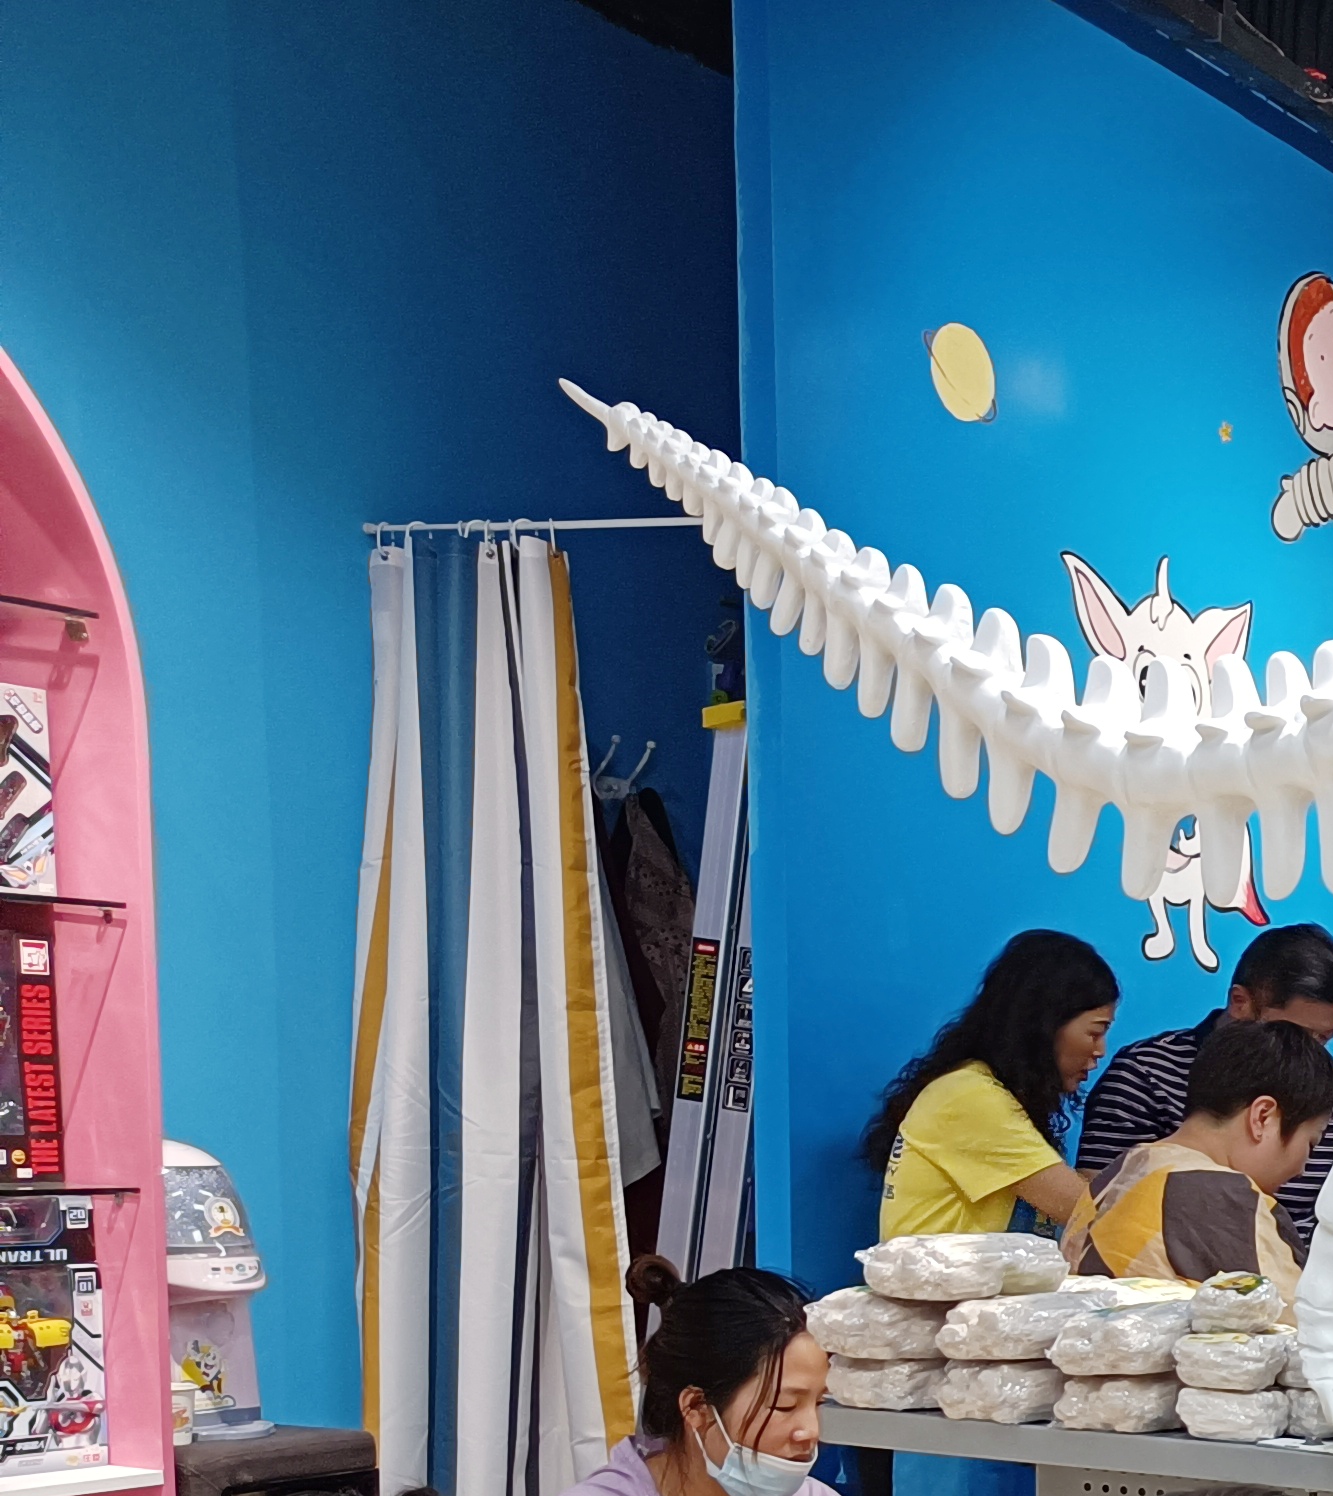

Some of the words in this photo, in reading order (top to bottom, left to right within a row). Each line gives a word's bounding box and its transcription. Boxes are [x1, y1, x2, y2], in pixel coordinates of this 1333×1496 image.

[20, 984, 54, 1056] SERIES
[24, 1061, 58, 1133] LATEST
[30, 1138, 60, 1175] THE
